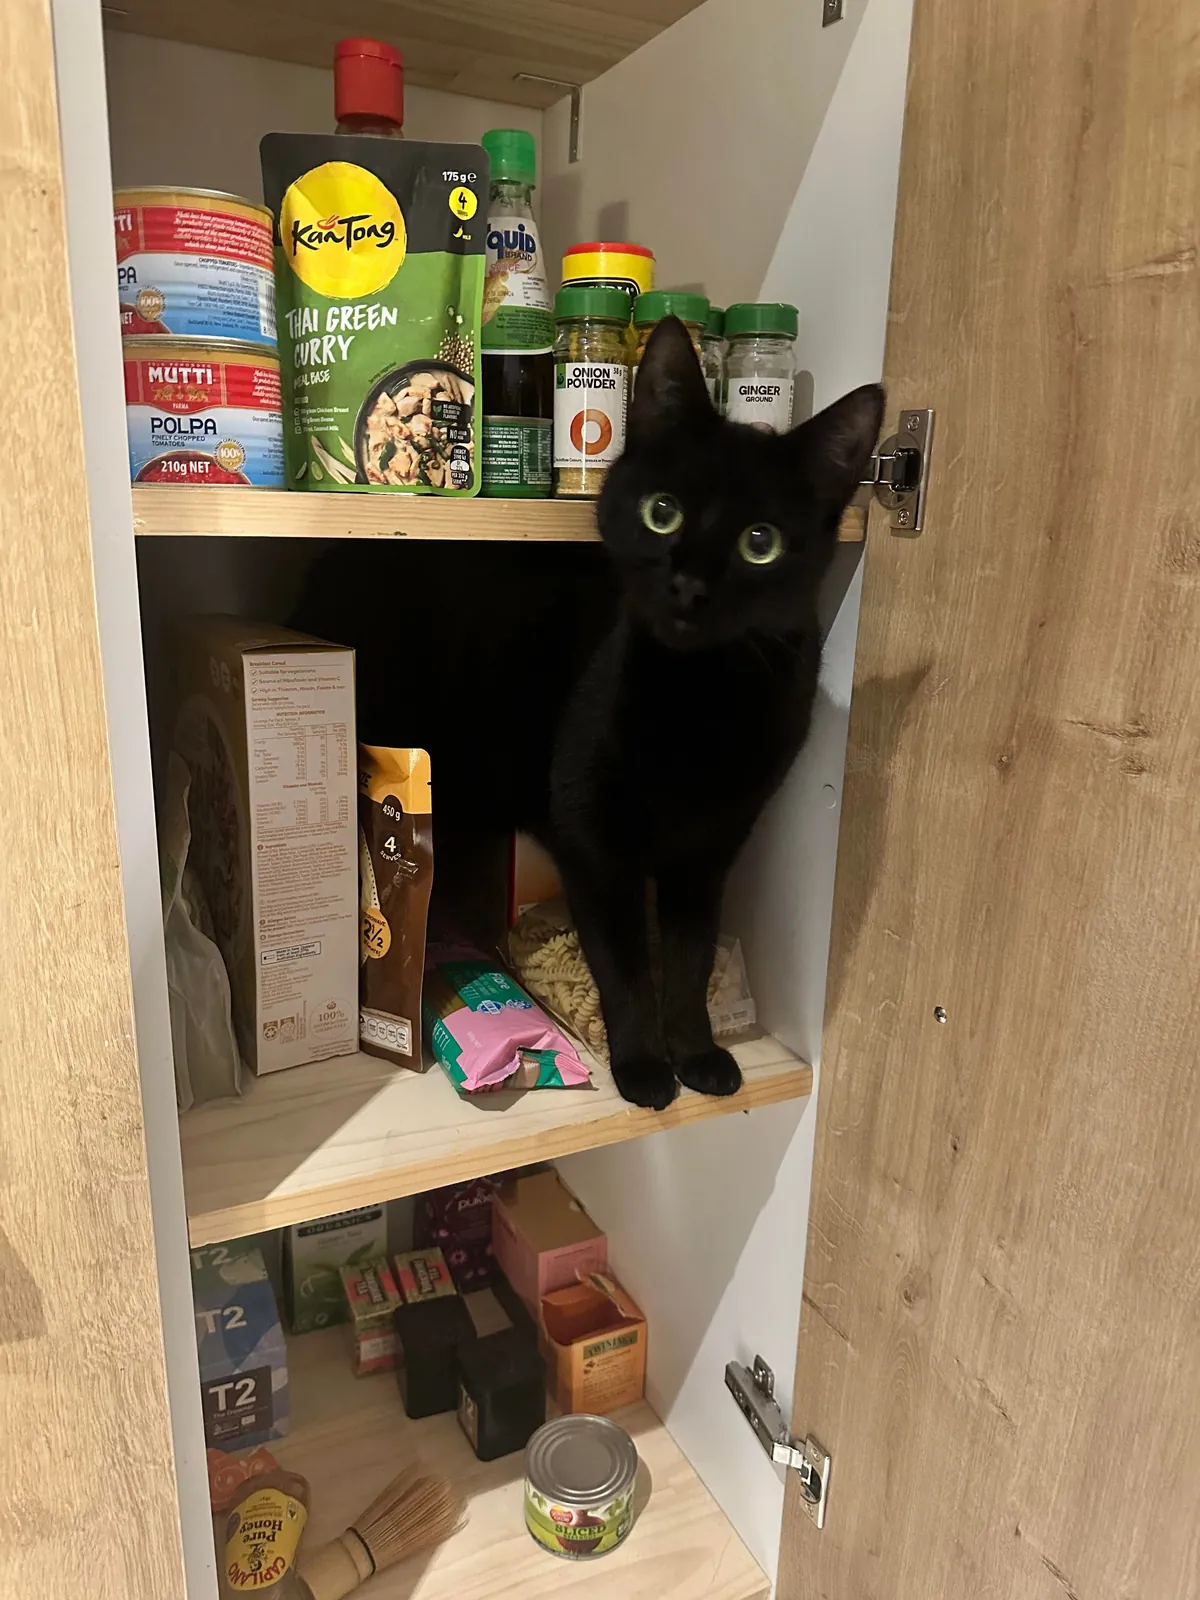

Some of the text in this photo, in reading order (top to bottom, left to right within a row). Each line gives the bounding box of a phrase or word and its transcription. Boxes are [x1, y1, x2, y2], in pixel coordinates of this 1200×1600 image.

[458, 191, 468, 210] 4
[505, 250, 533, 262] BRAND
[285, 303, 398, 340] THAI GREEN
[294, 335, 356, 369] CURRY
[149, 366, 213, 386] MUTTI
[310, 369, 331, 386] BASE
[573, 367, 611, 379] ONION
[567, 378, 616, 390] POWDER
[739, 385, 781, 396] GINGER
[151, 417, 217, 435] POLPA
[173, 434, 206, 443] CHOPPED
[449, 429, 458, 440] NO
[219, 447, 241, 460] 100%
[161, 460, 211, 476] 210g NET
[382, 804, 401, 822] 450 g
[384, 836, 397, 853] 4
[379, 849, 402, 862] SERVES
[191, 1247, 232, 1269] T2
[195, 1306, 248, 1333] T2
[208, 1377, 257, 1412] T2
[239, 1519, 283, 1534] Honey
[554, 1524, 607, 1538] SLICED
[243, 1532, 277, 1543] Pure
[228, 1556, 286, 1586] CAPILANO
